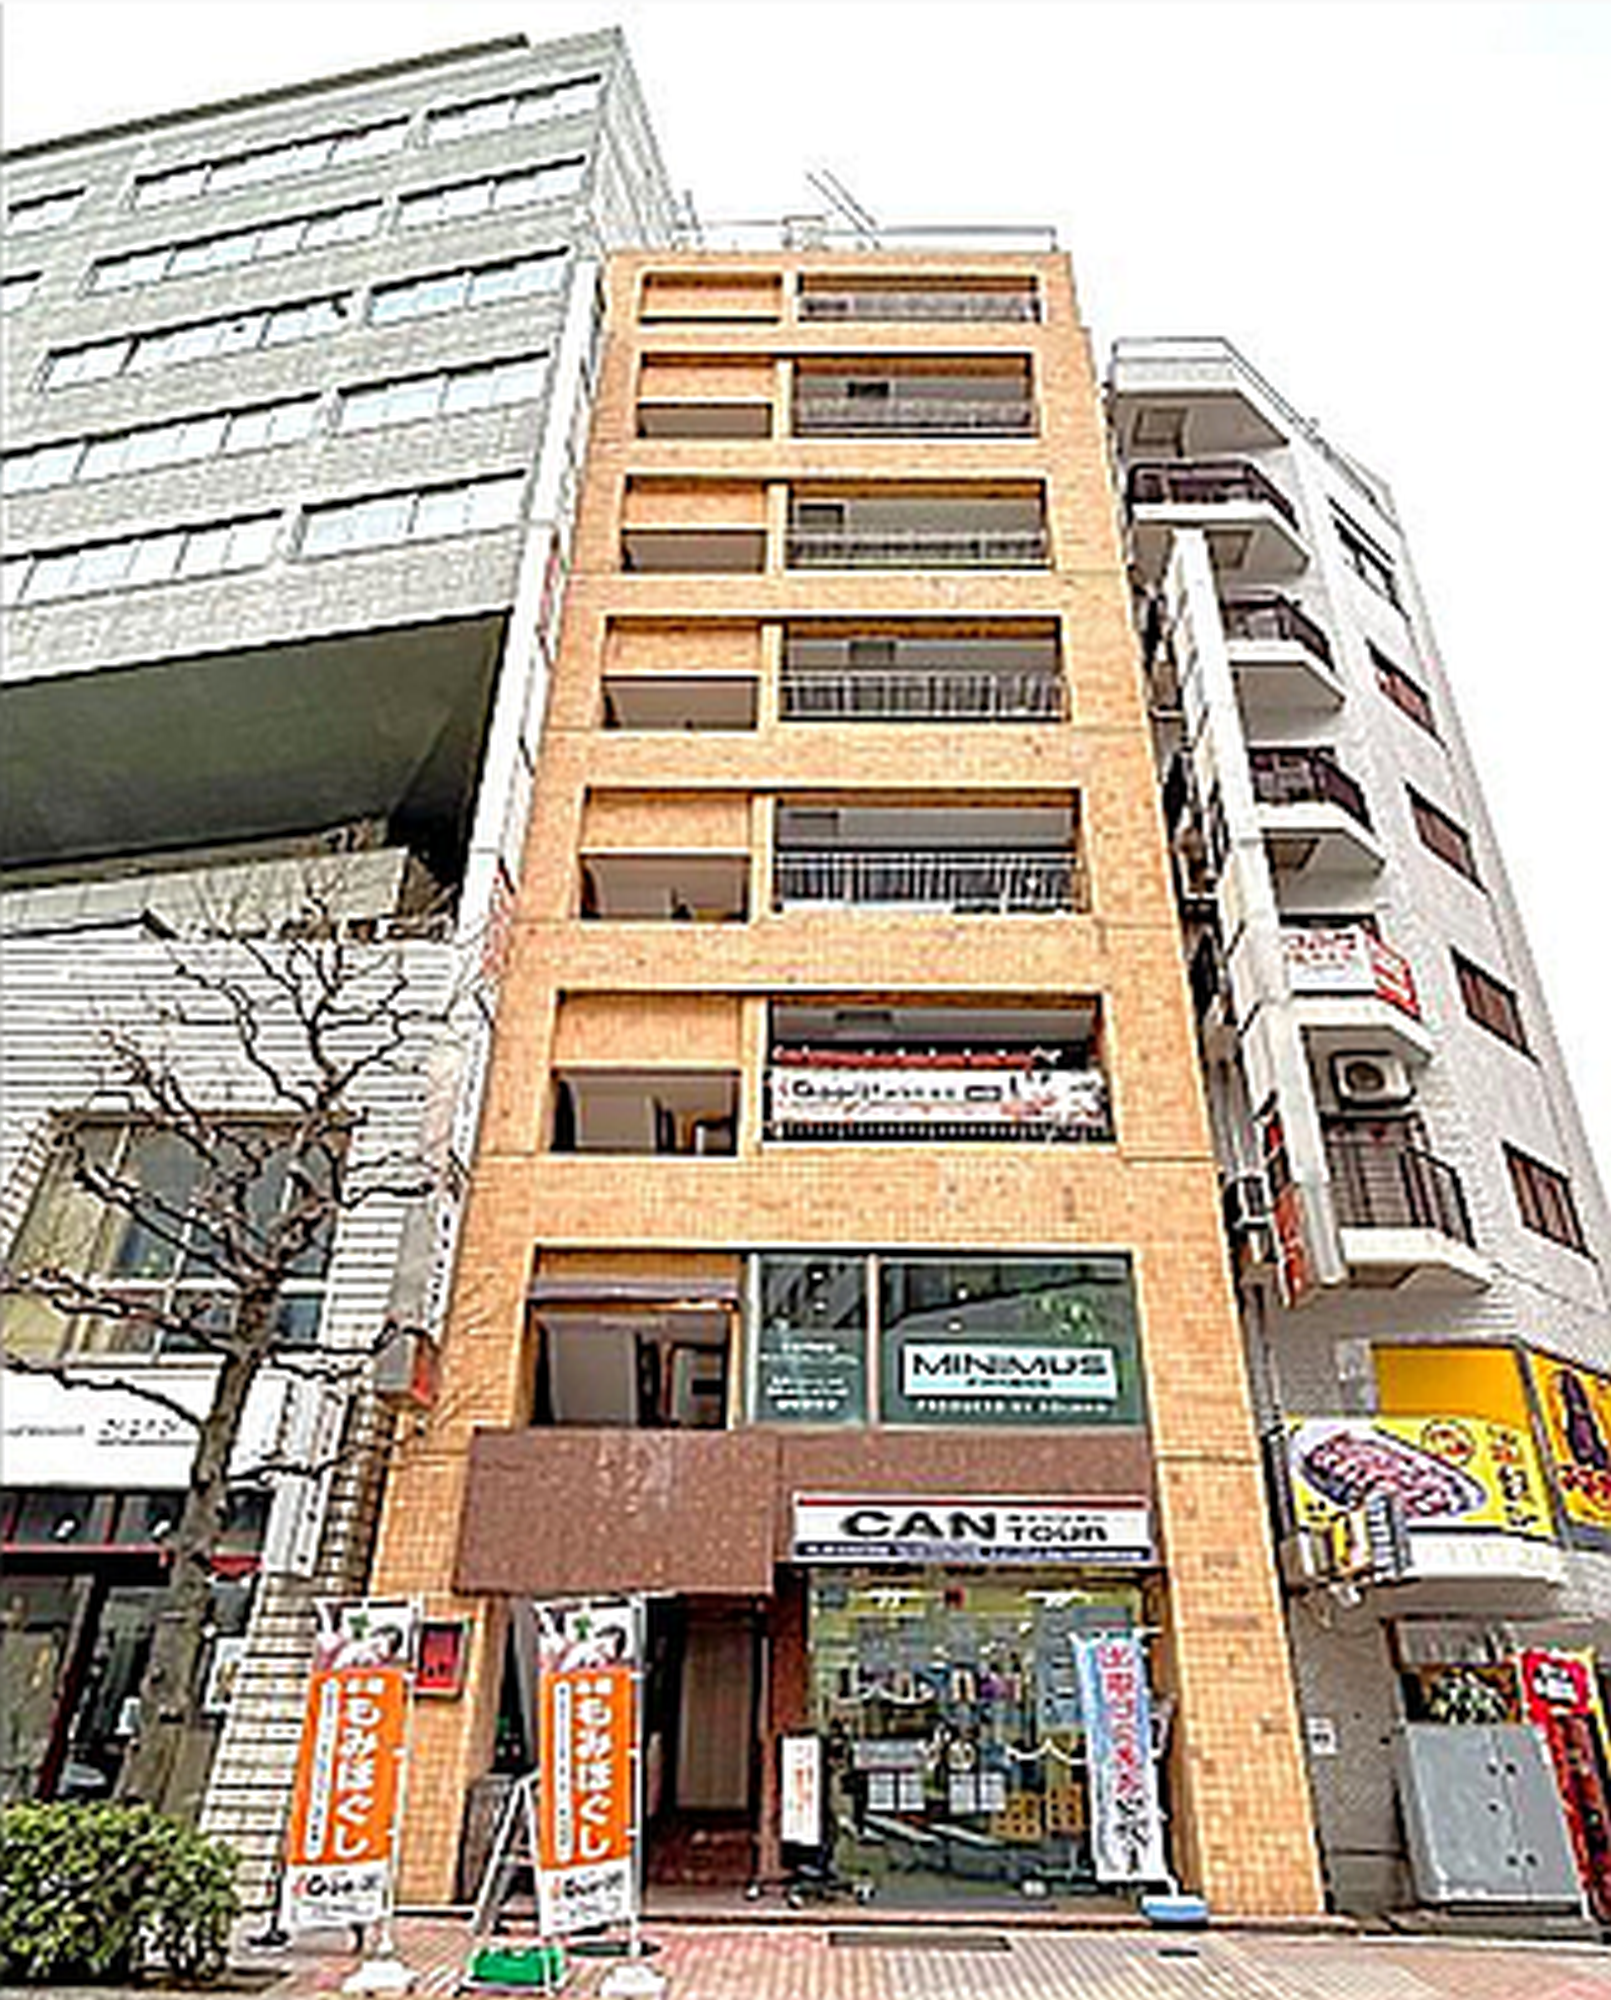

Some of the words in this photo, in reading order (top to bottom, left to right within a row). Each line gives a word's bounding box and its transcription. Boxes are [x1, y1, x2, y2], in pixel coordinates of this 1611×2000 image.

[912, 1353, 1108, 1377] MINIMUS
[840, 1511, 996, 1540] CAN
[1006, 1526, 1108, 1542] TOUR
[333, 1696, 382, 1857] もみほぐし
[575, 1698, 614, 1858] もみほぐし
